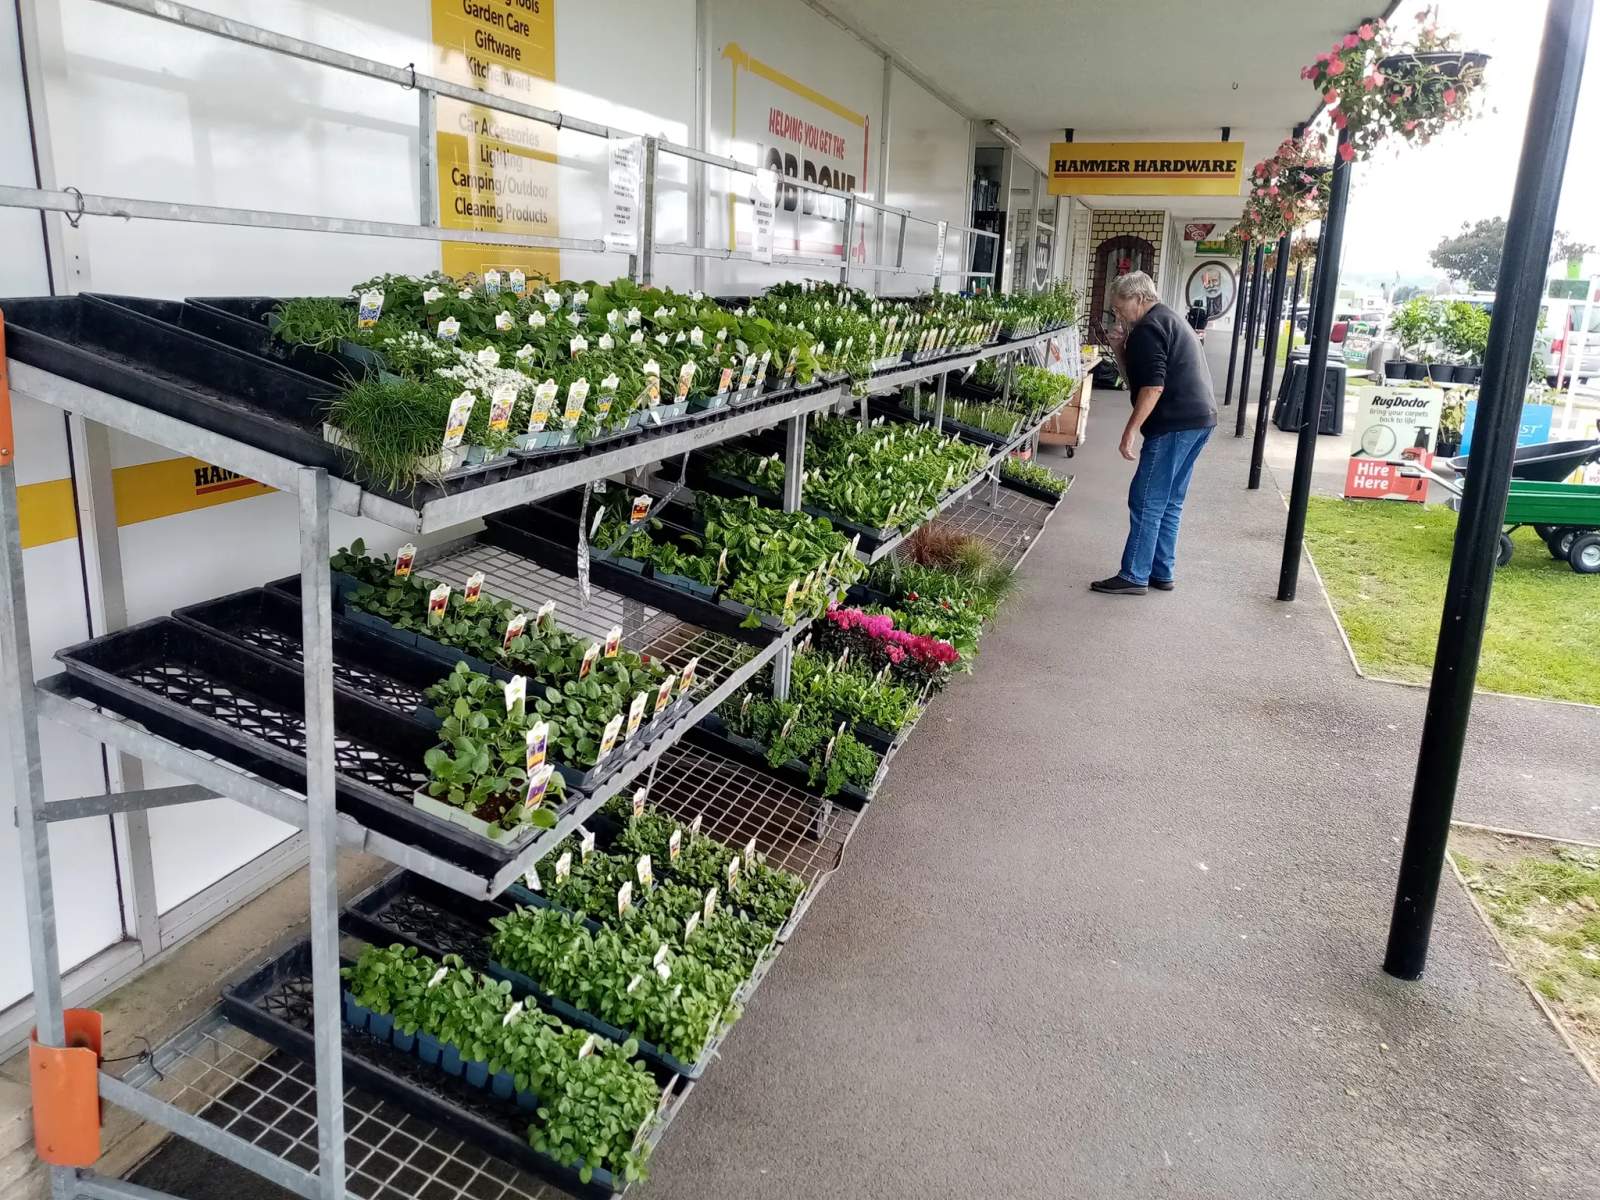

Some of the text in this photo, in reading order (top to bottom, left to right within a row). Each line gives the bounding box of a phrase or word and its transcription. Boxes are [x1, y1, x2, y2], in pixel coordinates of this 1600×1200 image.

[463, 0, 530, 37] Garden Care
[475, 29, 521, 61] Giftware
[459, 113, 479, 134] Car
[768, 107, 845, 160] HELPING YOU GET THE
[1054, 159, 1237, 173] HAMMER HARDWARE
[451, 167, 548, 198] Camping/Outdoor
[455, 196, 548, 223] Cleaning Products
[1353, 475, 1389, 489] Here
[1356, 462, 1389, 477] Hire
